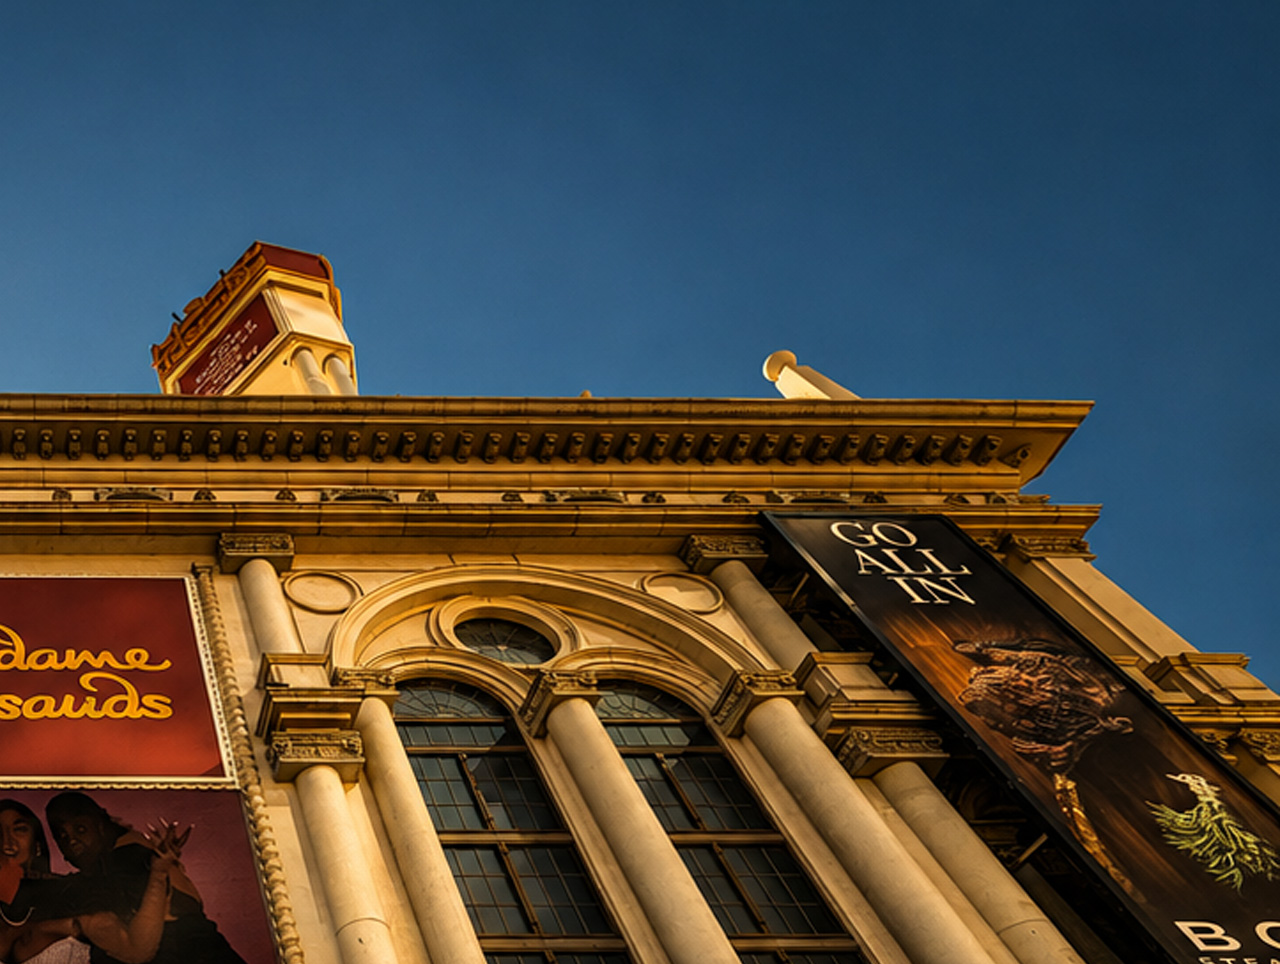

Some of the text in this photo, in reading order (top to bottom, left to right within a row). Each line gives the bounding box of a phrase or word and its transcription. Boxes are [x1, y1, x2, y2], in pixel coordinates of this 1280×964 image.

[830, 521, 918, 547] GO
[854, 548, 973, 575] ALL
[886, 576, 976, 605] IN
